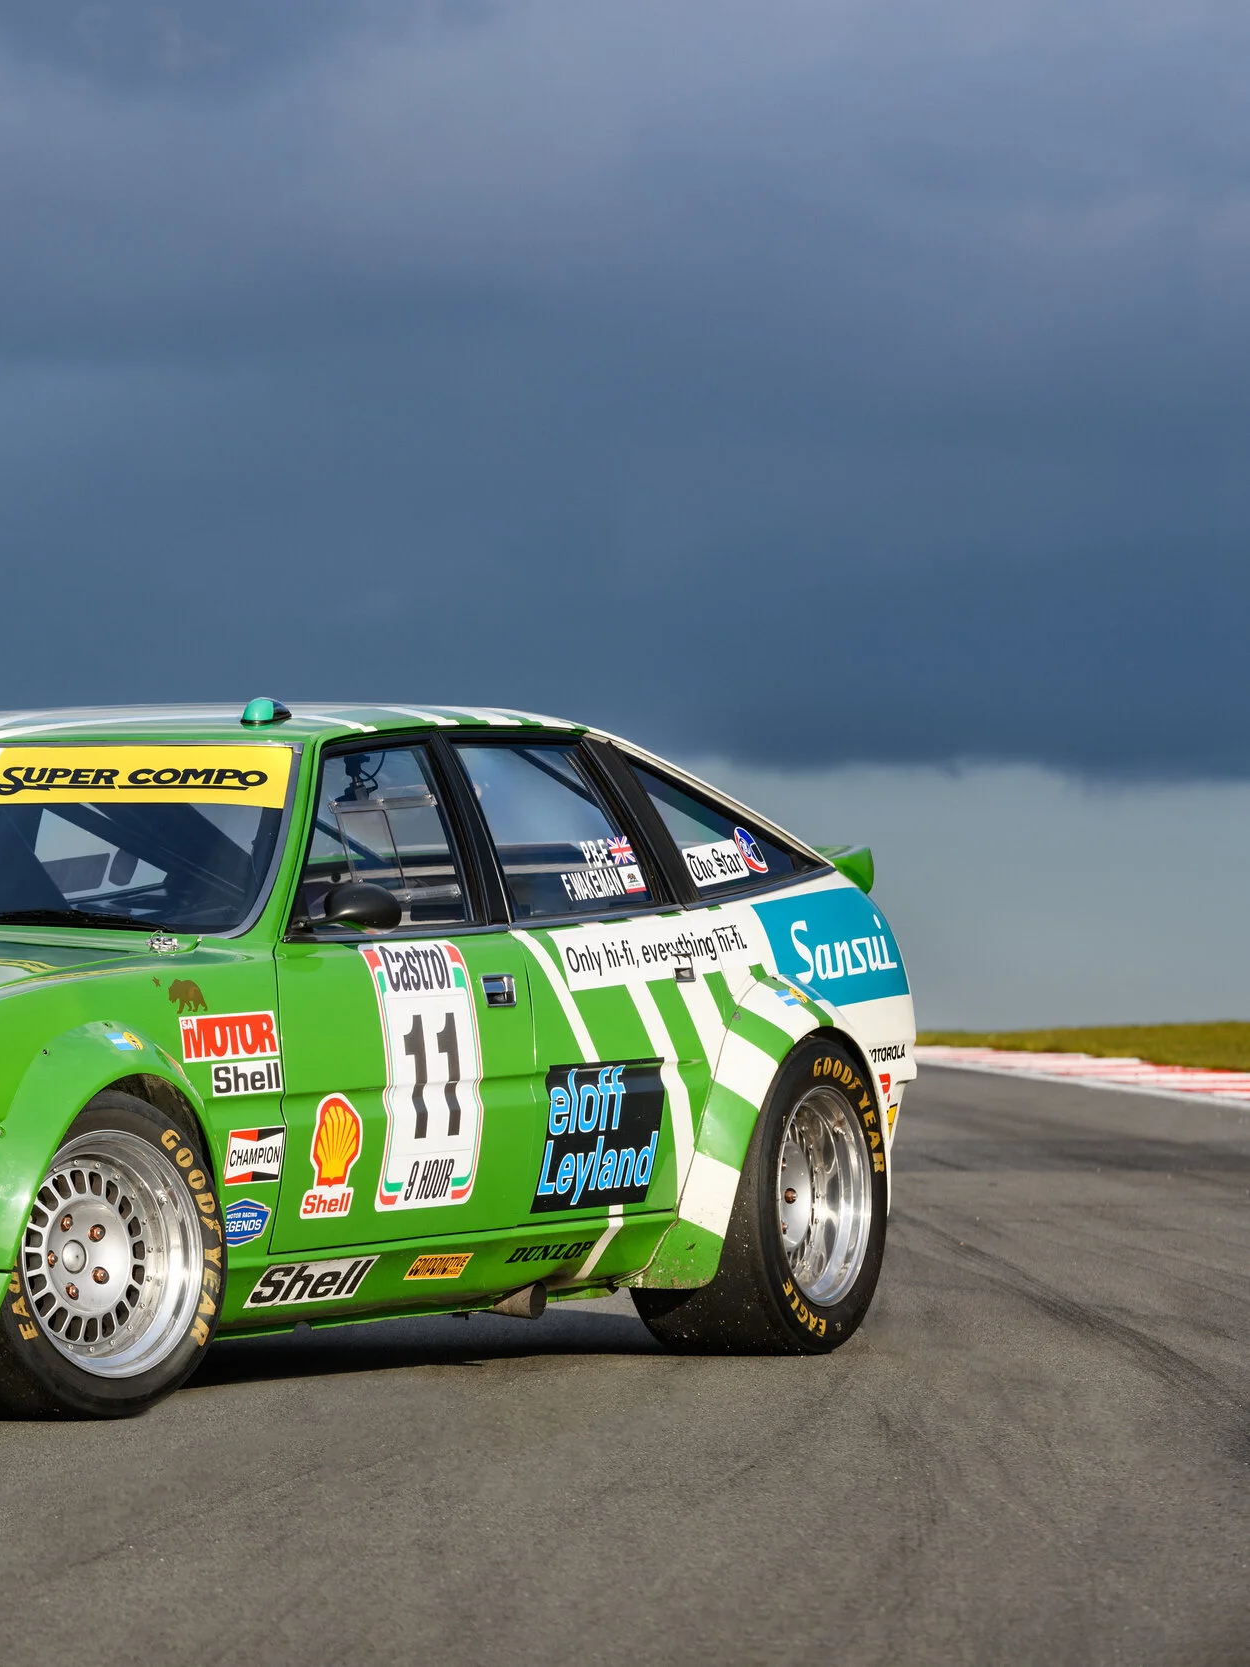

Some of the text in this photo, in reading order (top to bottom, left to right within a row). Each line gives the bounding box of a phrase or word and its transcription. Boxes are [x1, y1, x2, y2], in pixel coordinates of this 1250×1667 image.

[119, 768, 268, 791] COMPO
[687, 848, 744, 882] The Star
[379, 944, 451, 992] Castrol
[566, 925, 748, 976] Only hi-fi, everything hi-fi.
[790, 914, 897, 985] Sansui
[181, 1014, 278, 1059] SA MOTOR
[869, 1044, 905, 1063] OTOROLA
[214, 1062, 281, 1094] Shell
[403, 1012, 460, 1139] 11
[549, 1066, 626, 1135] eloff
[813, 1057, 885, 1173] GOODYEAR
[230, 1146, 281, 1167] CHAMPION
[538, 1131, 658, 1206] Leyland
[404, 1158, 454, 1201] 9 HOUR
[226, 1220, 262, 1232] EGENDS
[303, 1193, 350, 1214] Shell
[161, 1129, 222, 1347] GOODYEAR
[505, 1241, 595, 1263] DUNLOP
[249, 1258, 376, 1303] Shell
[782, 1278, 827, 1338] EAGLE
